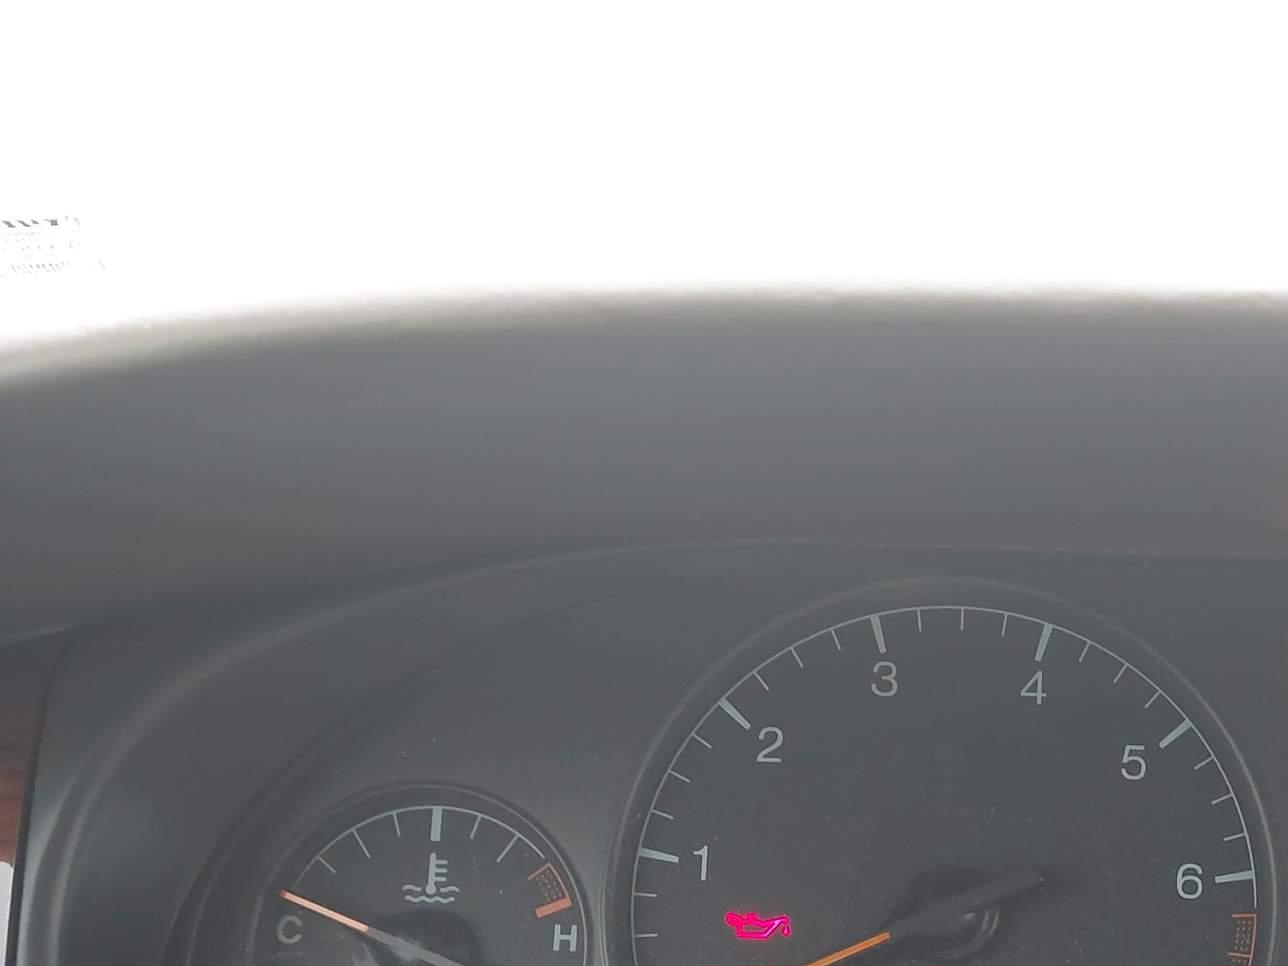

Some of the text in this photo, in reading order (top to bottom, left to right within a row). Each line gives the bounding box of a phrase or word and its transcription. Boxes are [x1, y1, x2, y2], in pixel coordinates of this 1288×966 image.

[871, 661, 899, 696] 3
[1020, 671, 1047, 704] 4
[756, 727, 783, 762] 2
[1121, 745, 1147, 780] 5
[693, 845, 708, 881] 1
[1176, 864, 1204, 899] 6
[276, 915, 302, 944] C
[553, 924, 577, 952] H
